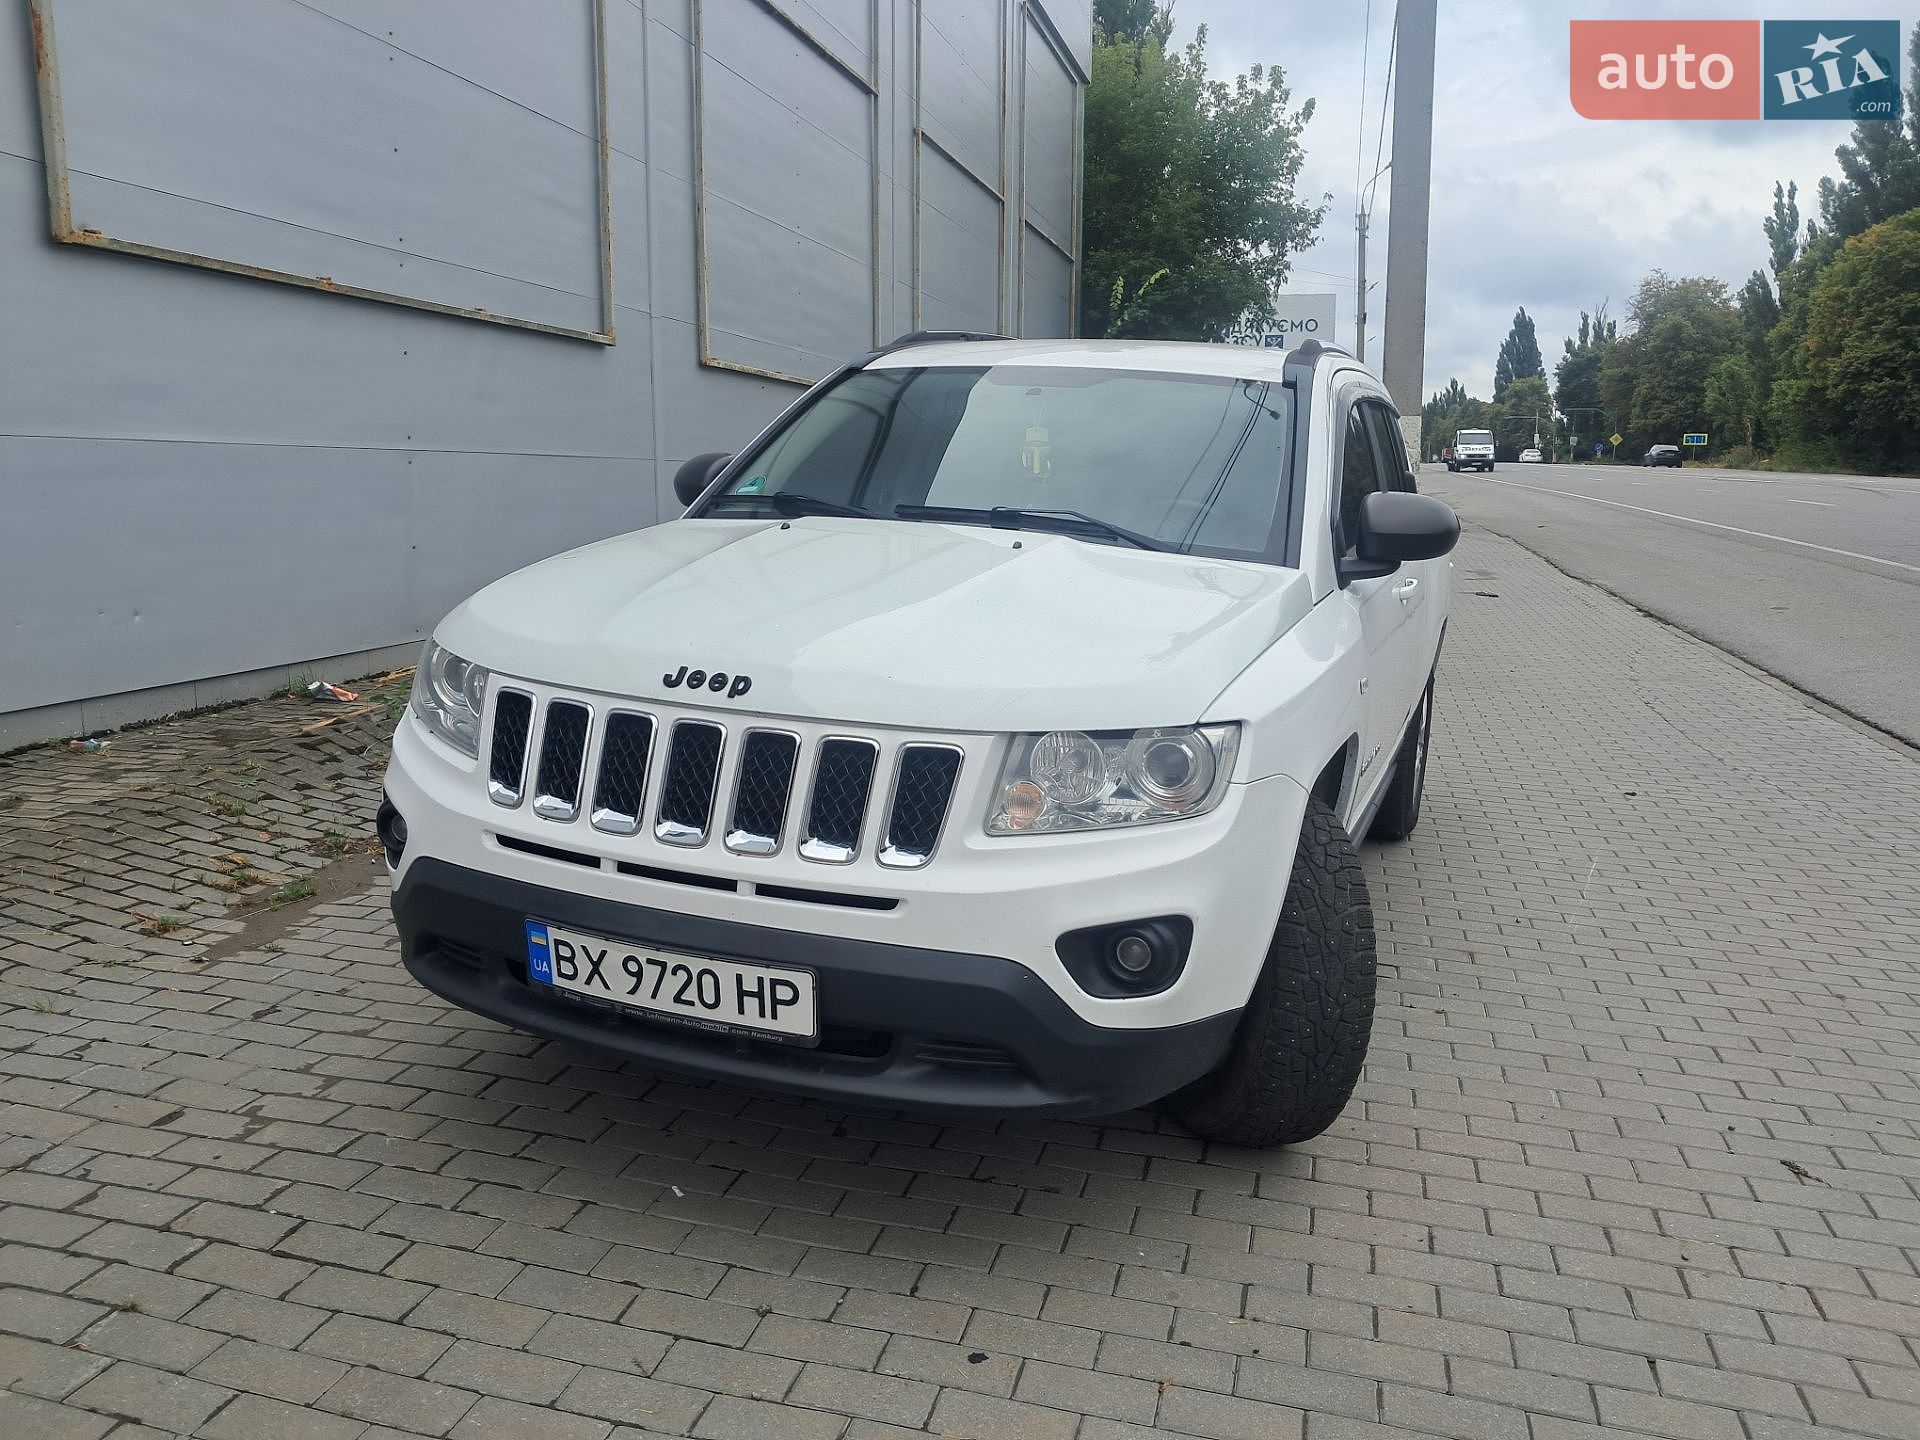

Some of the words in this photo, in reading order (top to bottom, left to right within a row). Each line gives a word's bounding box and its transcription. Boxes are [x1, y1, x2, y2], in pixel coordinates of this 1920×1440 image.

[662, 665, 753, 699] Jeep
[533, 958, 550, 975] UA
[552, 938, 612, 992] BX
[621, 954, 722, 1010] 9720
[735, 973, 801, 1021] HP
